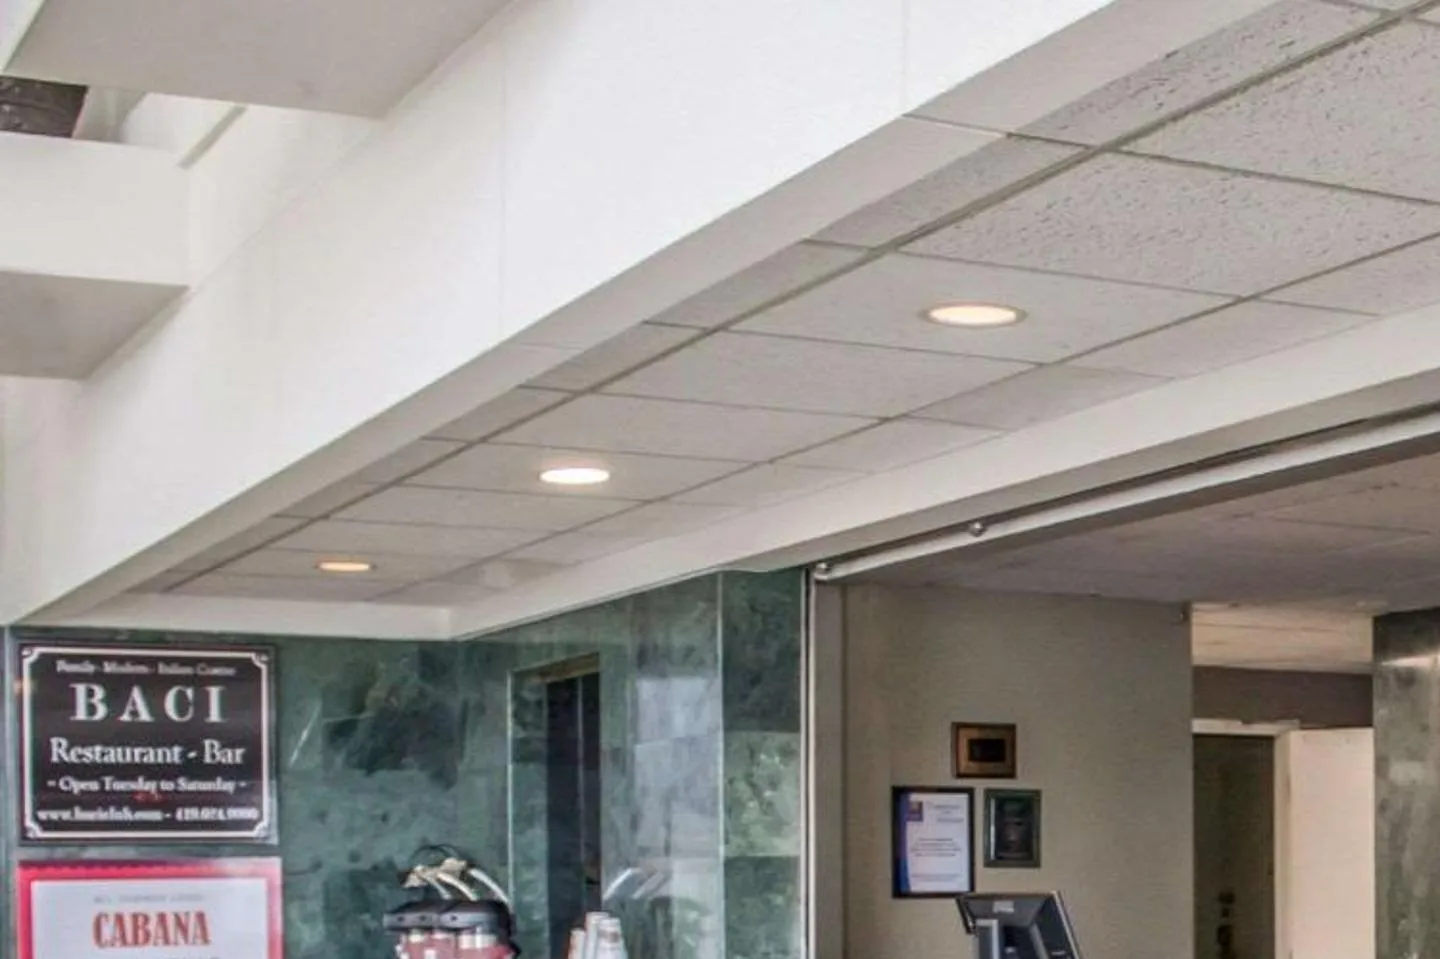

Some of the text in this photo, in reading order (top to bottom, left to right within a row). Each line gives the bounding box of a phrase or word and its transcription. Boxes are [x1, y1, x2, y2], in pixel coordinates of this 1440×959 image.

[69, 683, 228, 723] BACI
[50, 736, 183, 764] Restaurant
[203, 739, 246, 764] Bar
[58, 777, 99, 794] Open
[103, 776, 157, 794] Tuesday
[160, 779, 174, 791] to
[92, 911, 212, 949] CABANA
